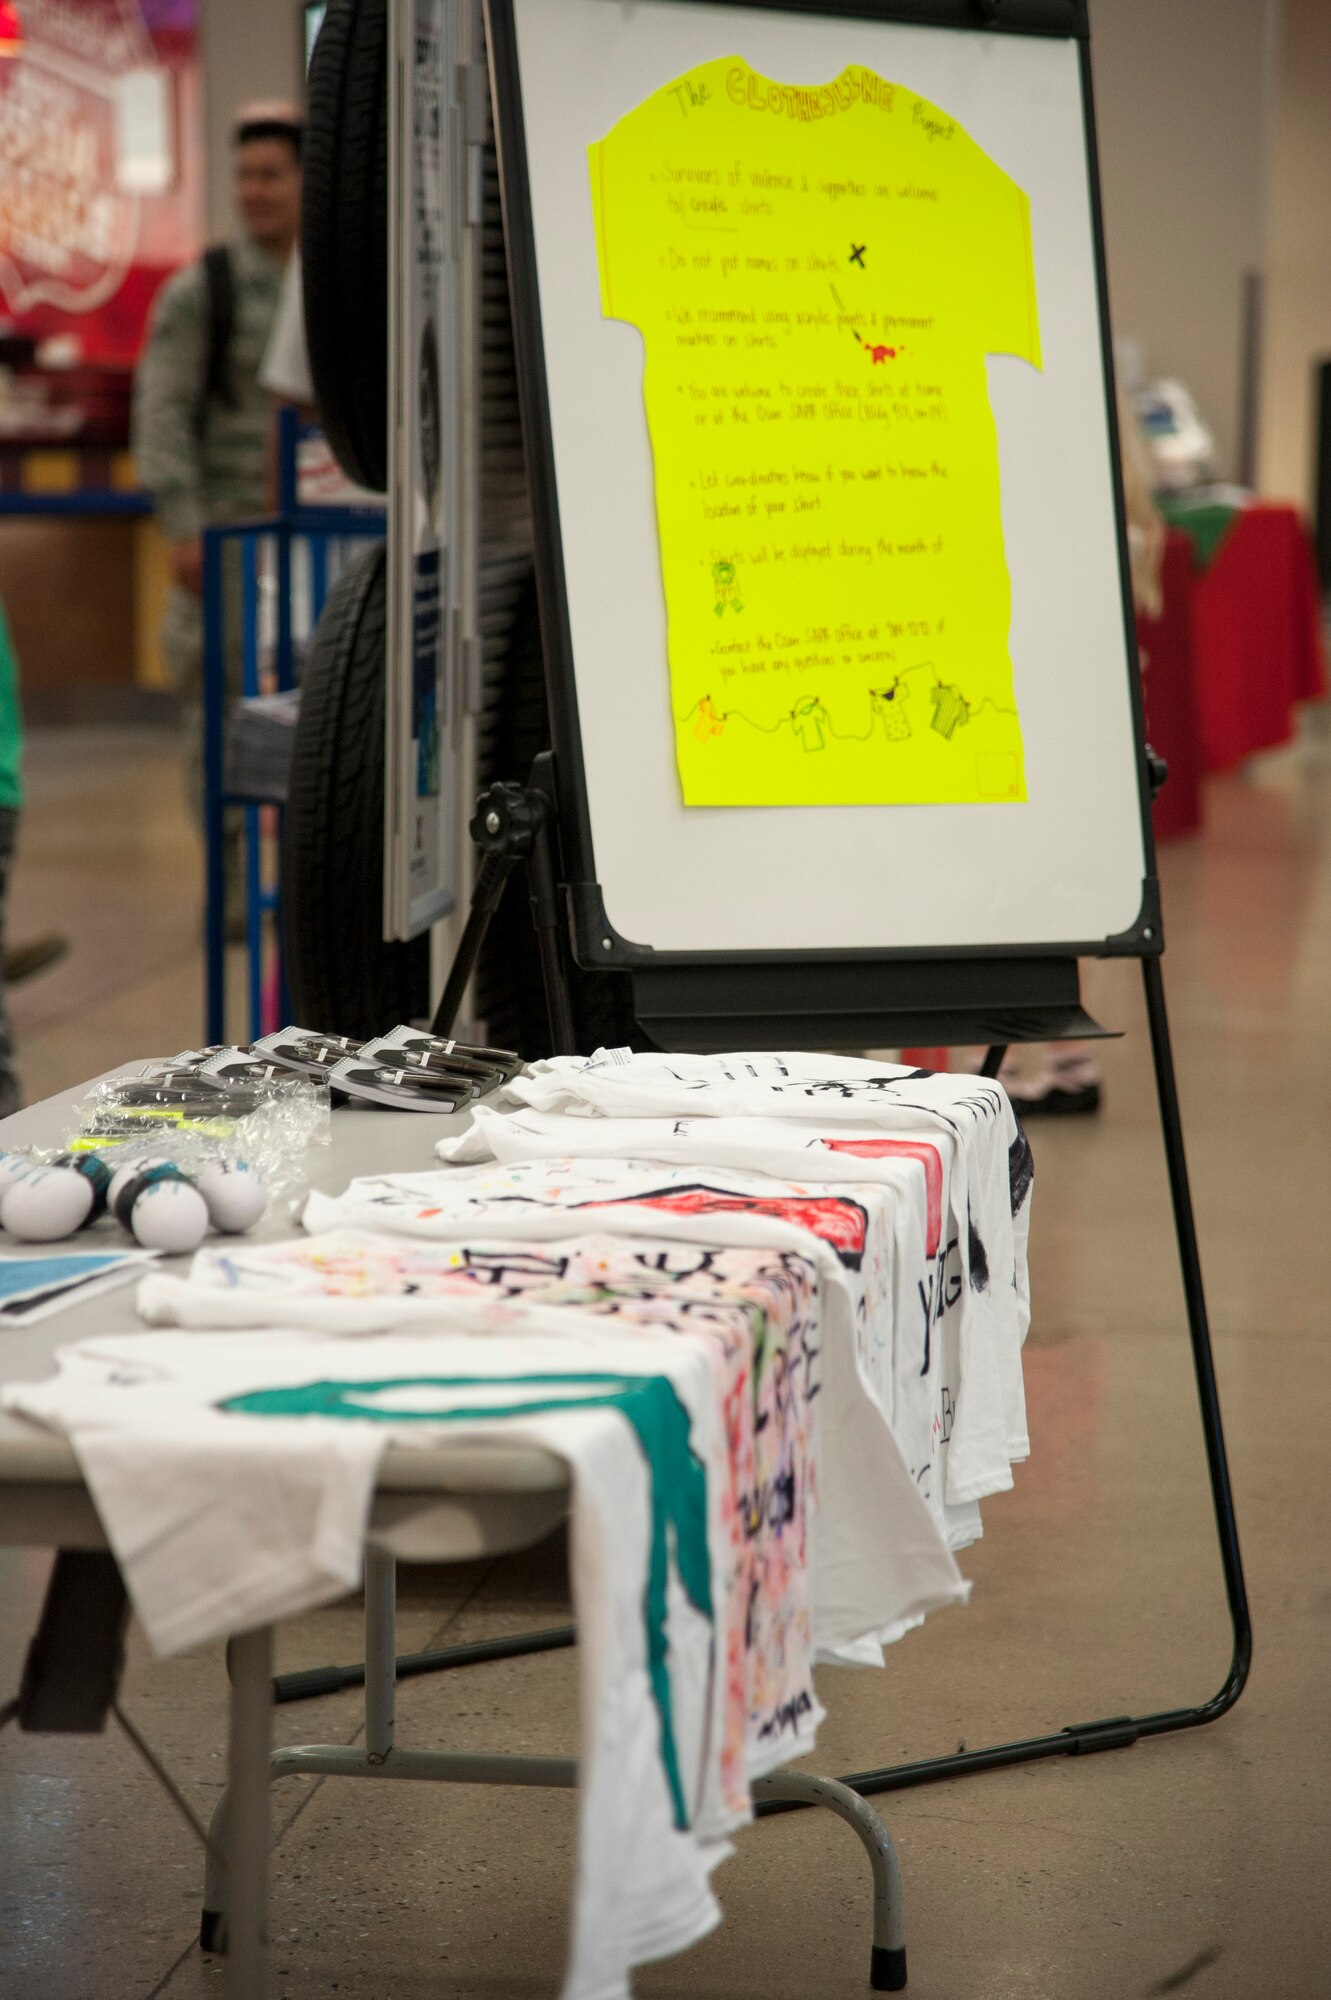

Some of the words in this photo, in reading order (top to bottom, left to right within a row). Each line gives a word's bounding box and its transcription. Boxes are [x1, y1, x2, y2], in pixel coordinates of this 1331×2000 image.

[666, 80, 712, 119] The
[910, 101, 956, 142] Project
[667, 247, 686, 272] Do
[692, 252, 712, 270] not
[721, 253, 739, 280] put
[784, 254, 800, 273] on
